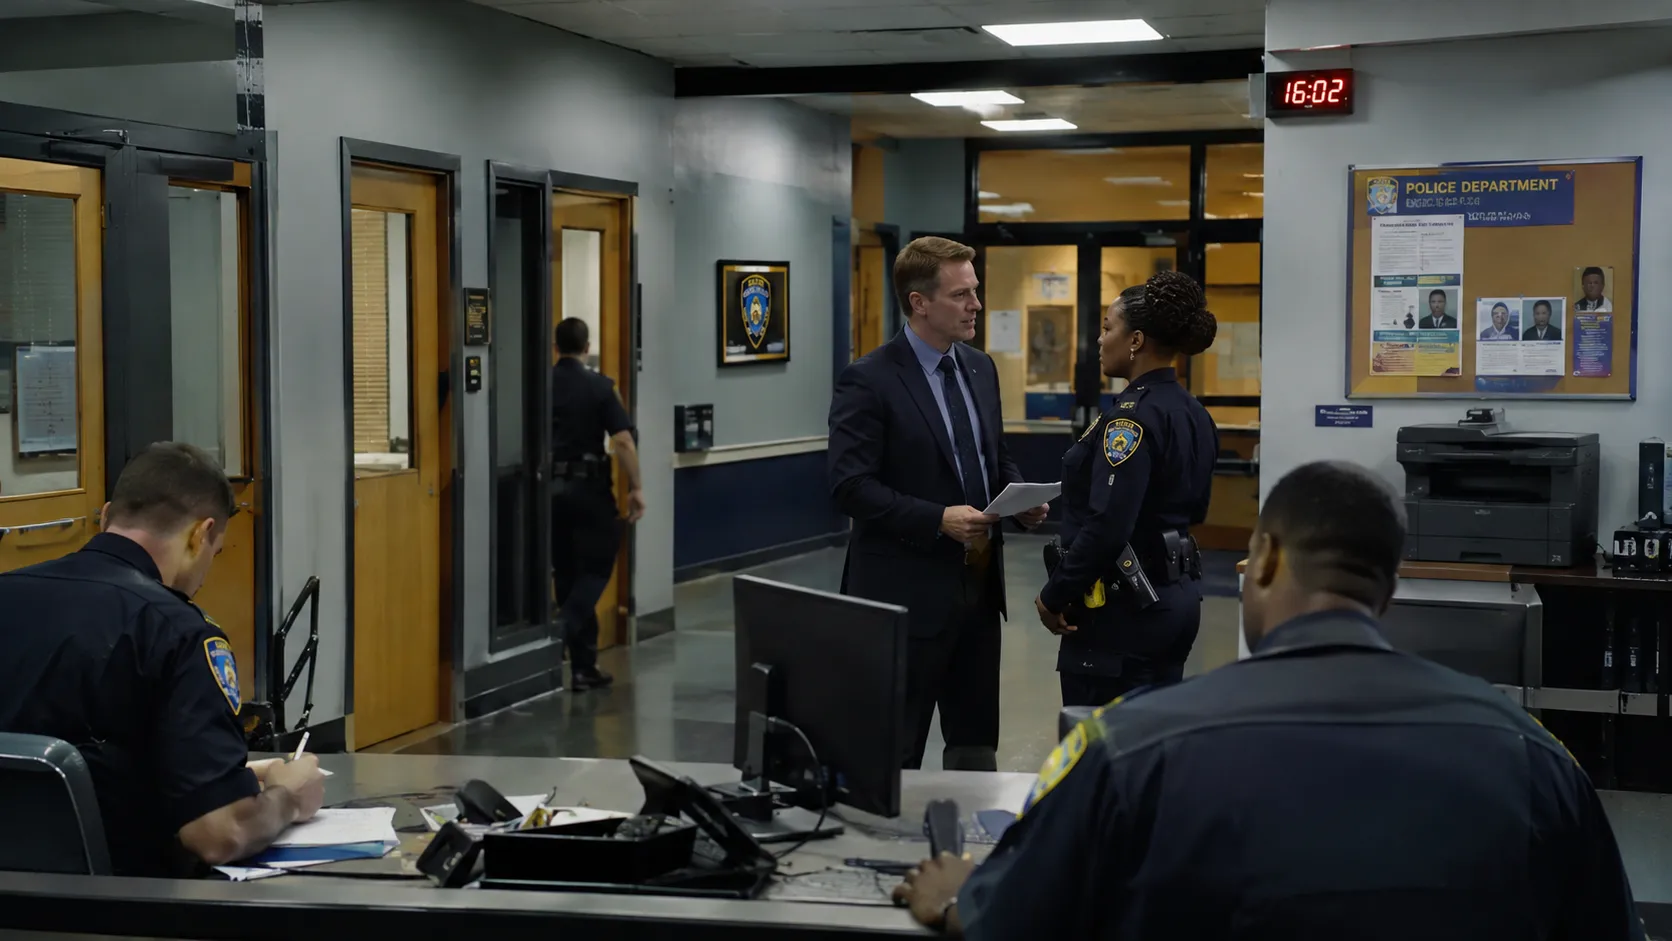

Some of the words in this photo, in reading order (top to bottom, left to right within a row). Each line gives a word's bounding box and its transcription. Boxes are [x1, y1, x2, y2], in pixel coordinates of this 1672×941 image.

[1284, 79, 1344, 104] 16:02
[1406, 181, 1456, 195] POLICE
[1461, 178, 1559, 194] DEPARTMENT
